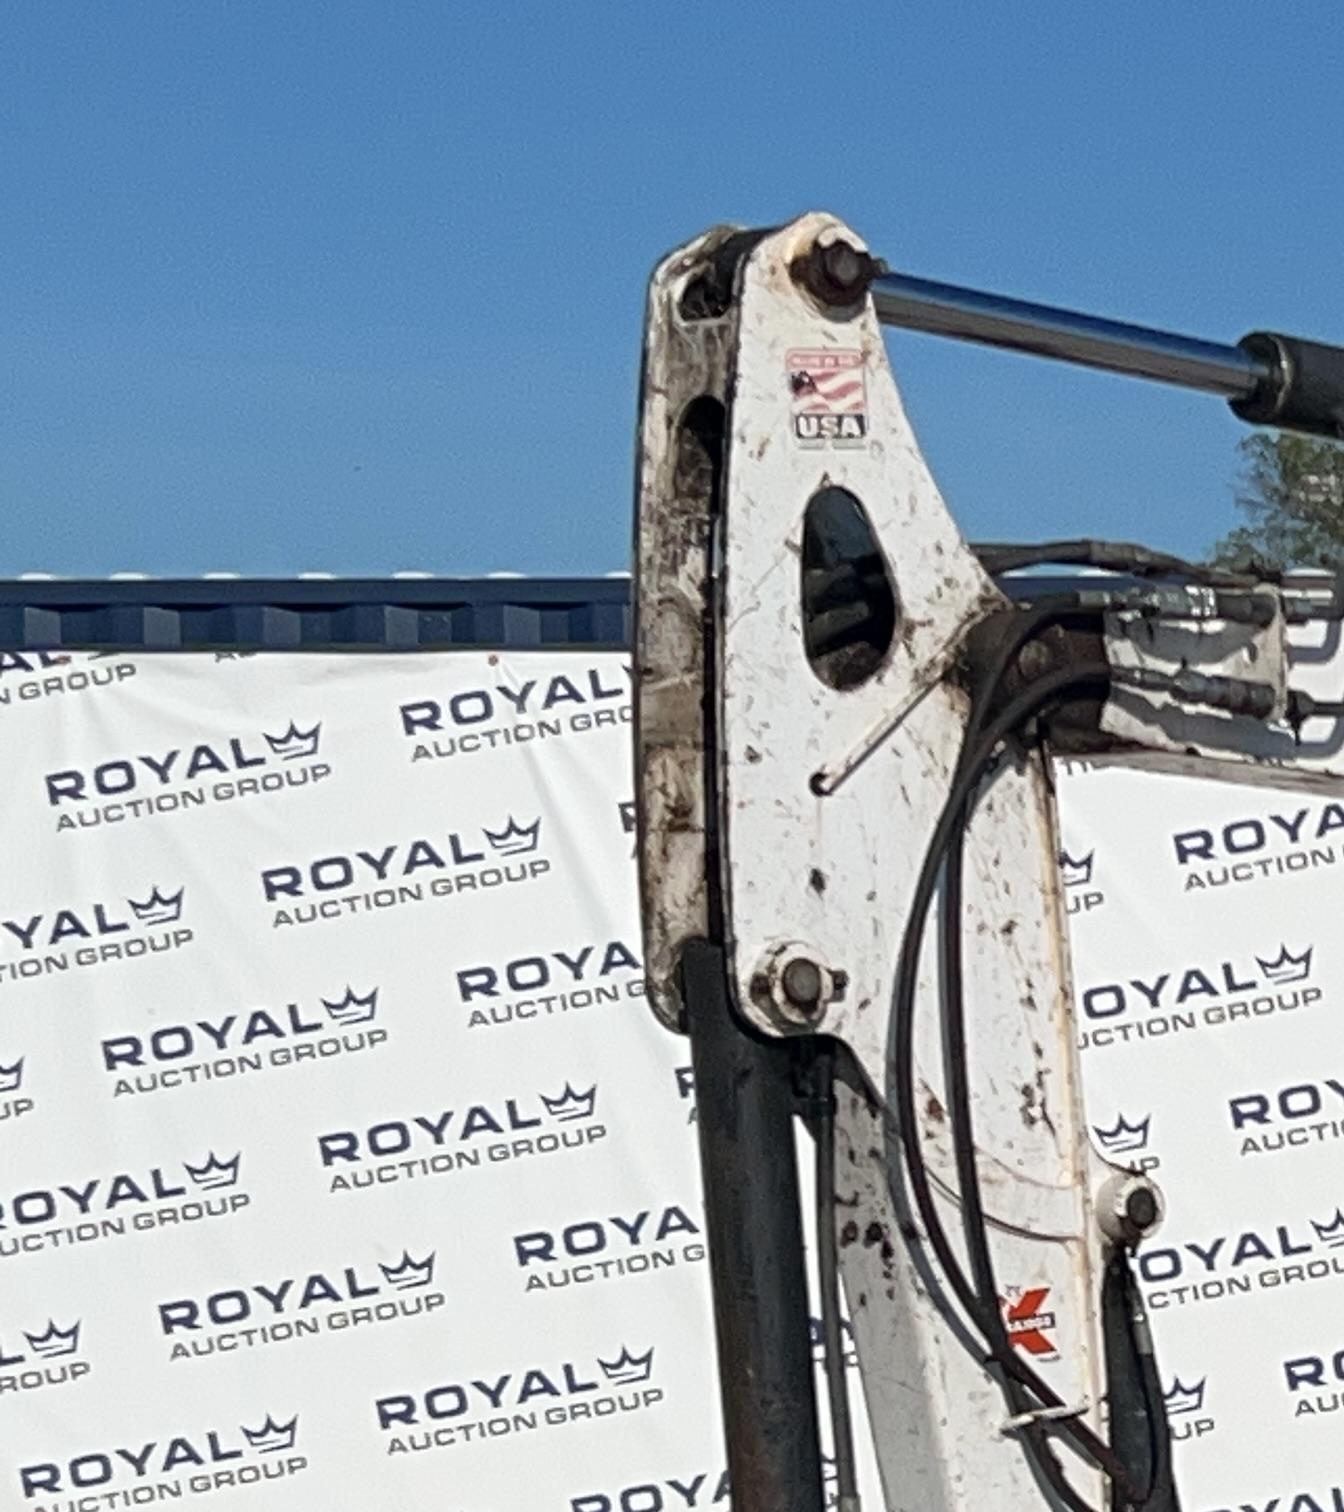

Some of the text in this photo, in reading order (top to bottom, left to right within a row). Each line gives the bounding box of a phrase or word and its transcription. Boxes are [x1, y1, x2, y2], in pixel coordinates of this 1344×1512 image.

[797, 415, 862, 438] USA
[18, 663, 137, 701] GROUP
[398, 668, 624, 737] ROYAL
[44, 737, 267, 807] ROYAL
[411, 718, 562, 763] AUCTION
[56, 763, 332, 833] AUCTION GROUP
[260, 832, 486, 903] ROYAL
[272, 859, 551, 929] AUCTION GROUP
[1185, 846, 1336, 891] AUCTION
[2, 904, 131, 950] YAL
[75, 928, 194, 967] GROUP
[455, 940, 643, 1003] ROYA
[1081, 961, 1259, 1020] OYAL
[467, 983, 621, 1028] AUCTION
[1202, 987, 1323, 1025] GROUP
[100, 1003, 324, 1072] ROYAL
[113, 1028, 388, 1098] AUCTION GROUP
[317, 1099, 543, 1168] ROYAL
[329, 1124, 607, 1193] AUCTION GROUP
[0, 1168, 187, 1229] OYAL
[0, 1193, 251, 1257] UCTION GROUP
[512, 1205, 700, 1268] ROYA
[1139, 1226, 1313, 1283] OYAL
[157, 1267, 381, 1336] ROYAL
[525, 1248, 676, 1293] AUCTION
[170, 1292, 446, 1362] AUCTION GROUP
[0, 1361, 91, 1394] ROUP
[375, 1362, 600, 1431] ROYAL
[387, 1388, 664, 1456] AUCTION GROUP
[19, 1430, 244, 1499] ROYAL
[188, 1456, 308, 1494] GROUP
